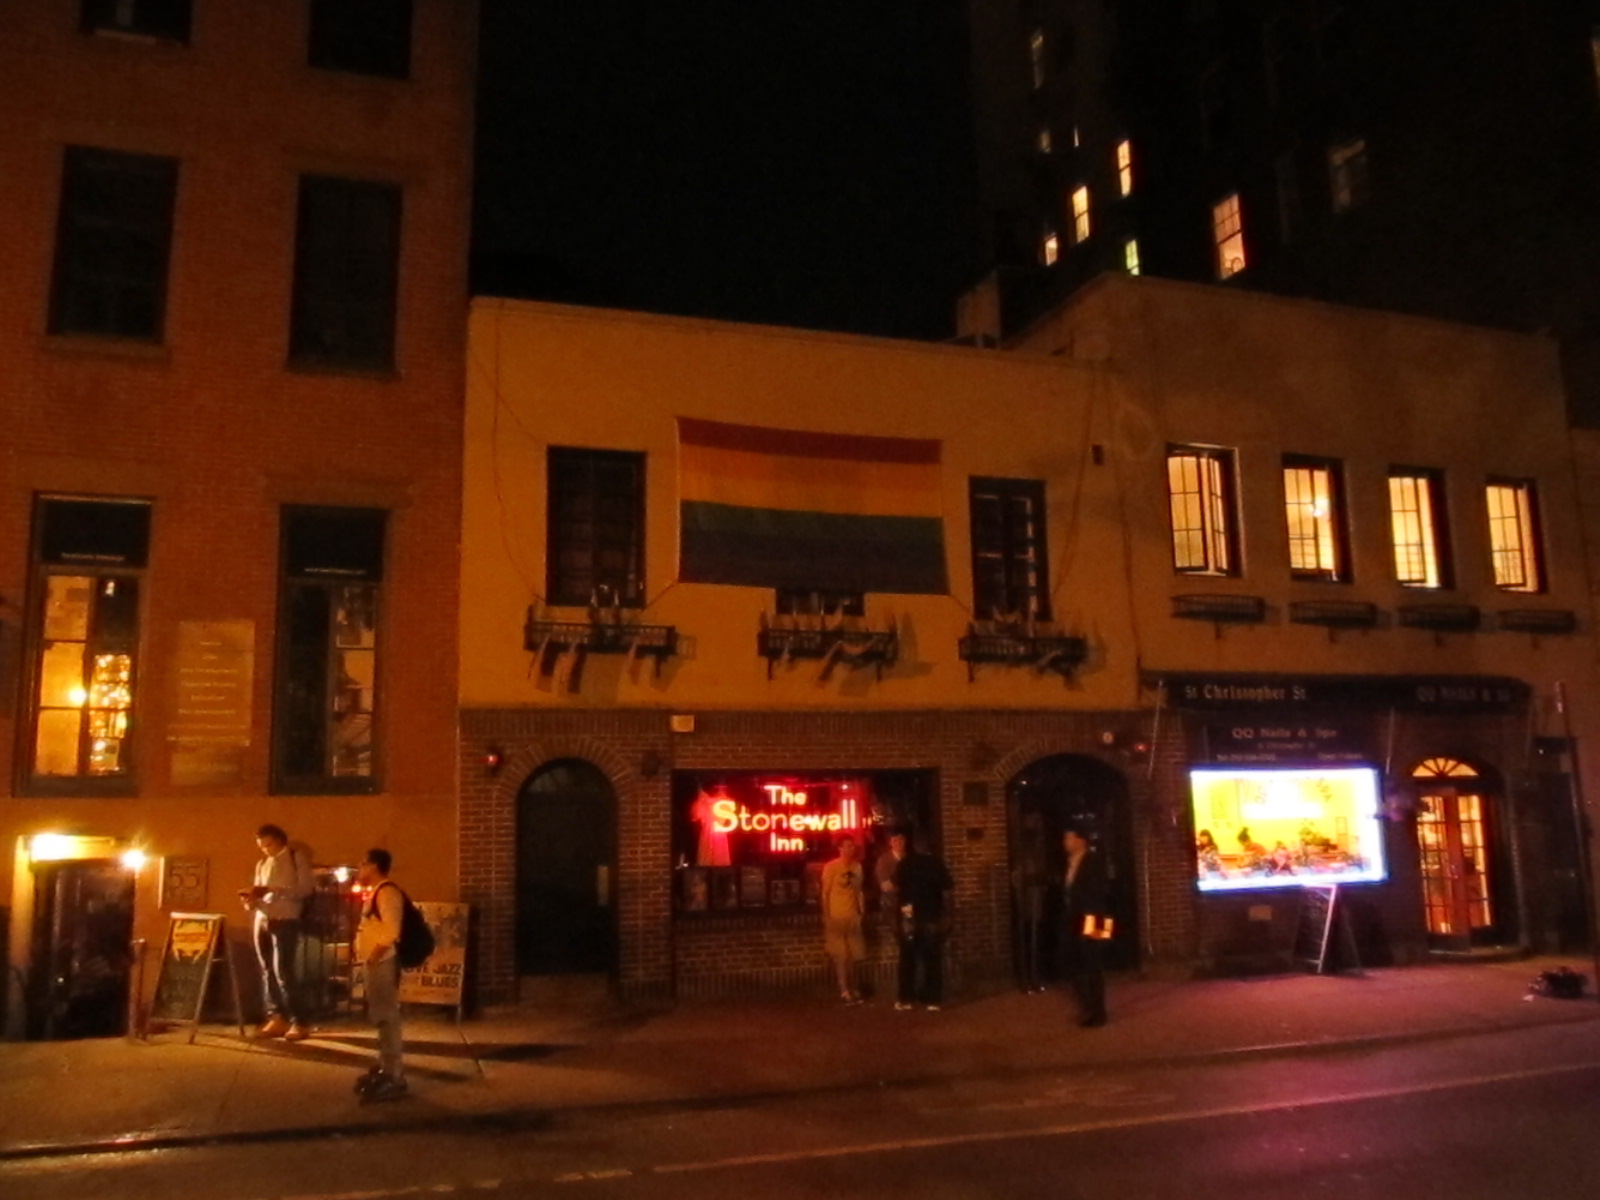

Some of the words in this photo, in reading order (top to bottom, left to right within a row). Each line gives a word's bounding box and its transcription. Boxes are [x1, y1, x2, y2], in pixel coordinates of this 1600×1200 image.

[1203, 684, 1285, 702] Christopher
[1291, 685, 1306, 700] St
[1231, 727, 1254, 739] QQ
[763, 785, 806, 805] The
[711, 799, 855, 832] Stonewall
[769, 832, 803, 852] Inn
[168, 865, 200, 889] 55
[433, 963, 462, 975] JAZZ
[421, 975, 459, 988] BLUES
